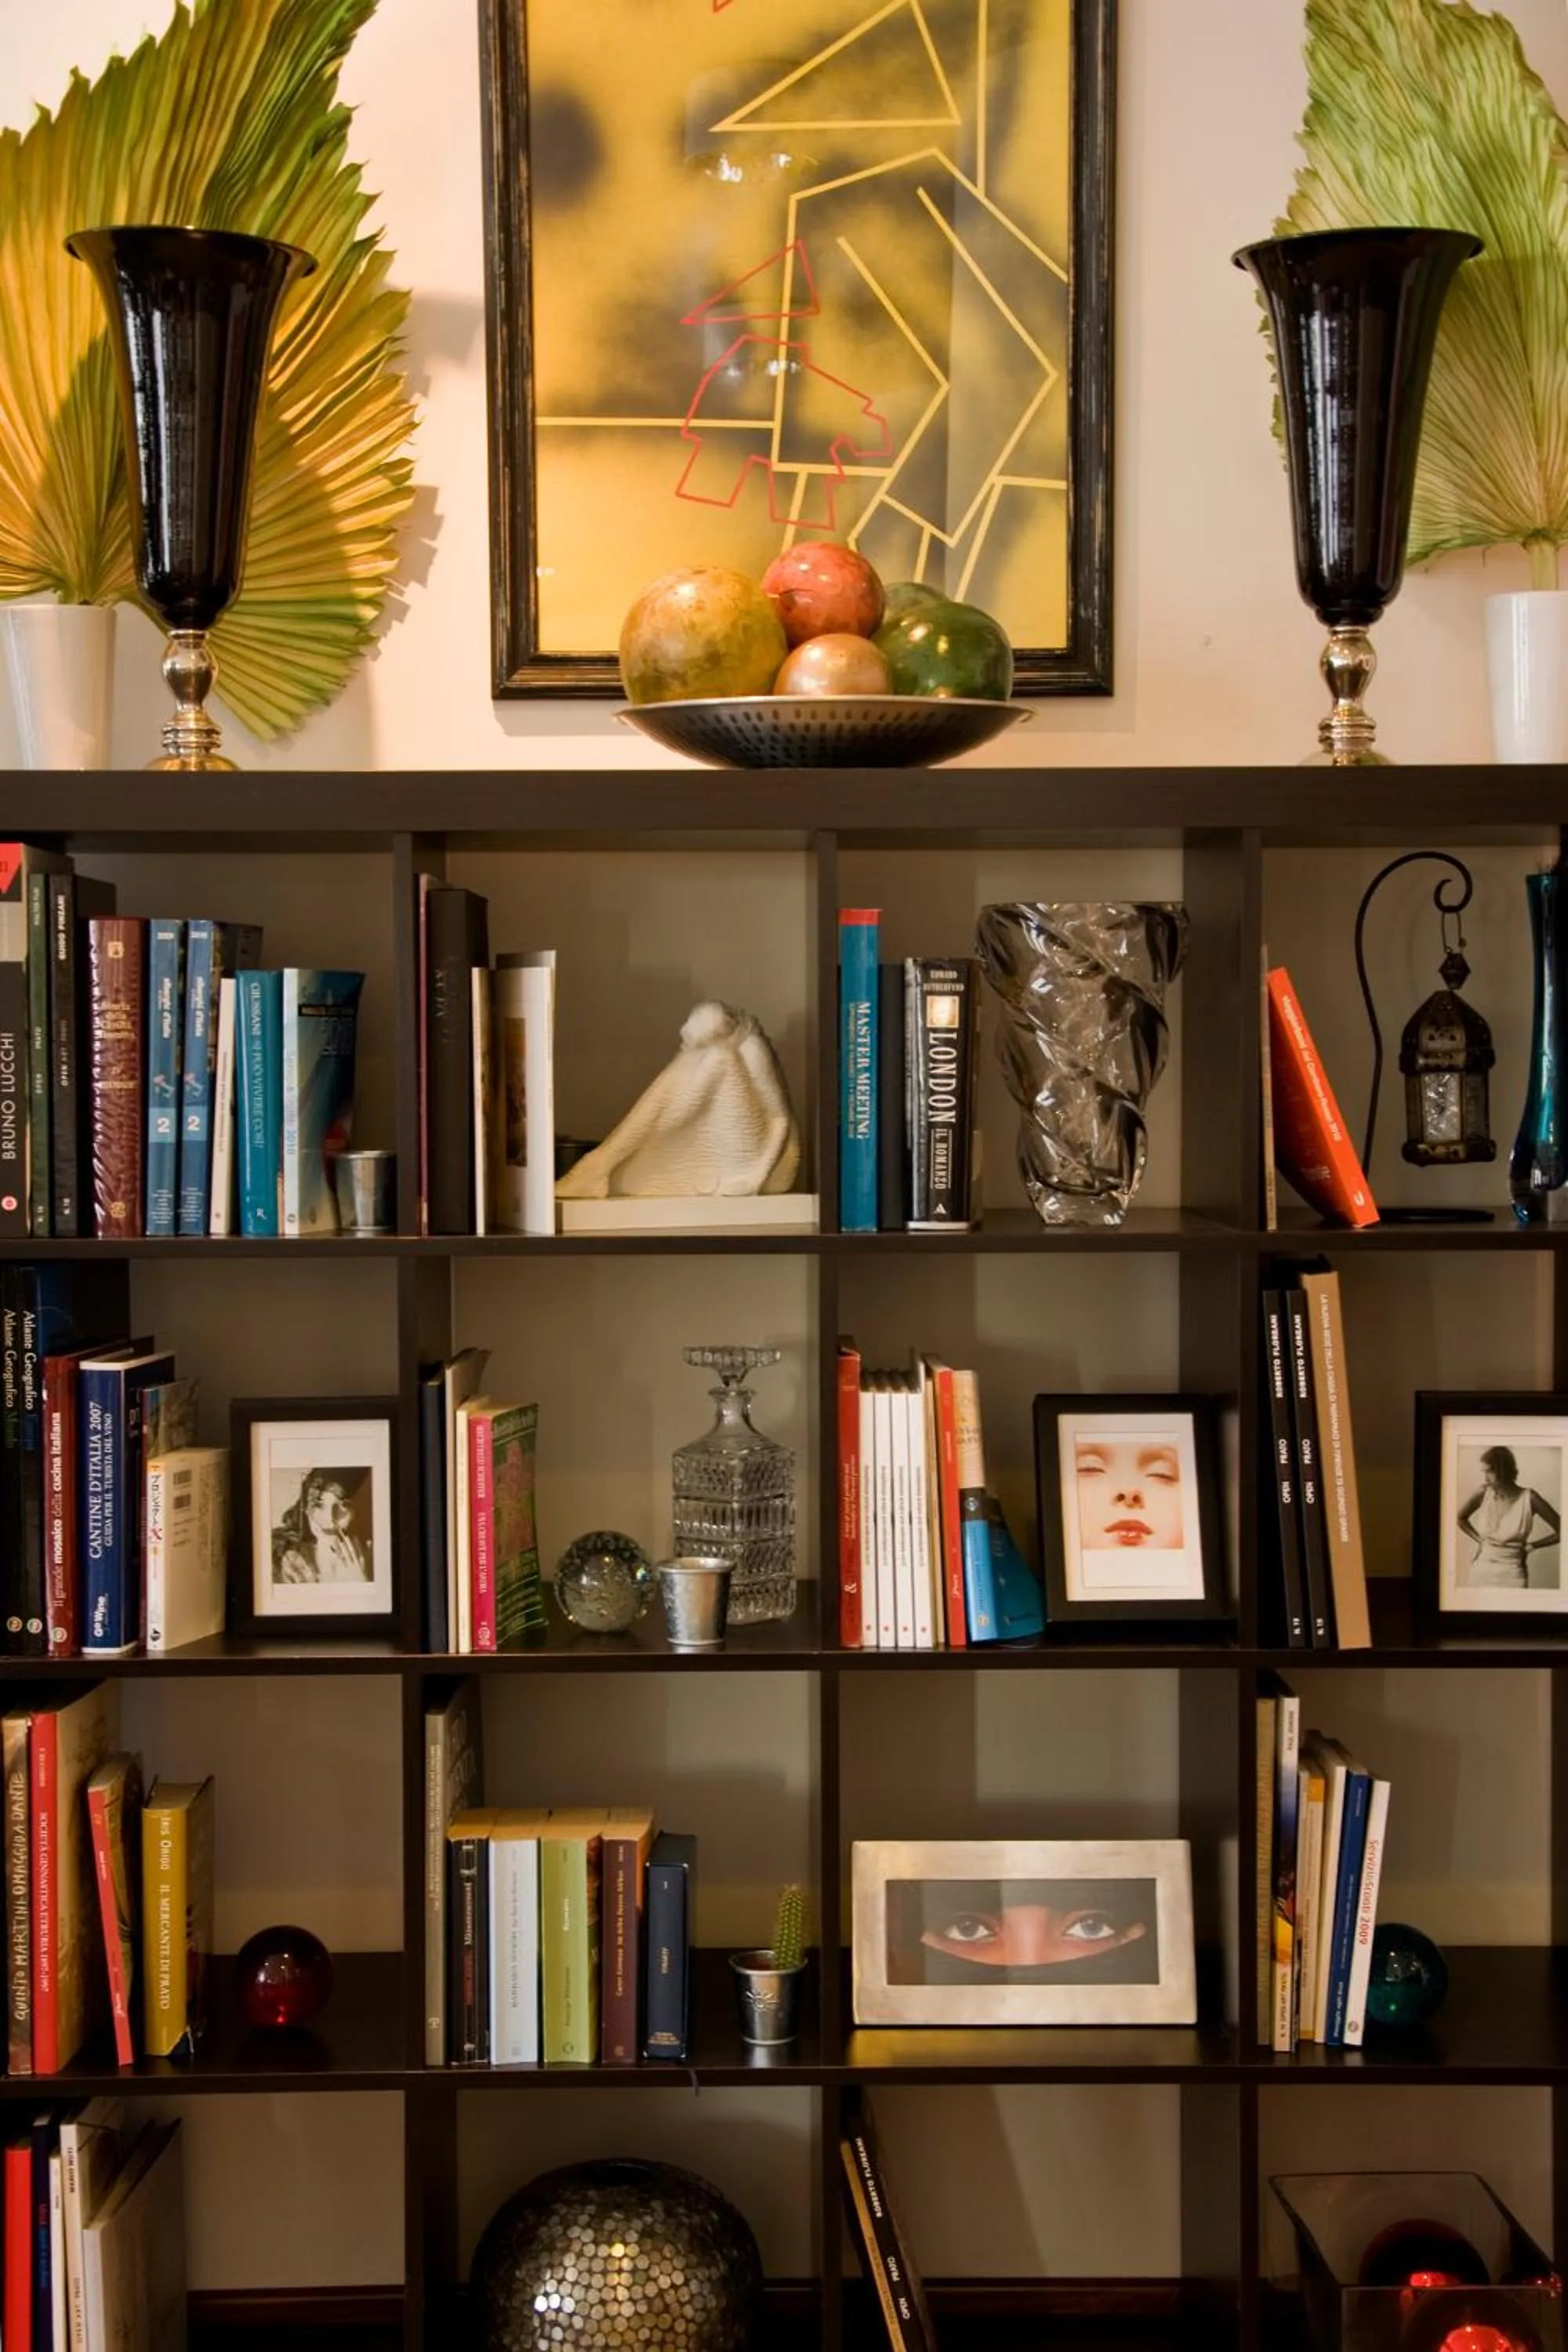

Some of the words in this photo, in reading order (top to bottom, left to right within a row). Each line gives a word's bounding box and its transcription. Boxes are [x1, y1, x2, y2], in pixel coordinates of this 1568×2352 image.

[57, 932, 67, 960] GUIDO
[250, 982, 261, 1036] GIUSSANI
[856, 1002, 871, 1068] MASTER
[1, 1032, 15, 1093] LUCCHI
[928, 1032, 957, 1123] LONDON
[252, 1077, 264, 1116] VIVERE
[855, 1071, 871, 1140] MEETING
[1, 1100, 16, 1160] BRUNO
[157, 1116, 170, 1133] 2
[187, 1115, 201, 1131] 2
[935, 1128, 948, 1139] IL
[934, 1142, 948, 1189] ROMANZO
[3, 1308, 16, 1347] Atlante
[23, 1310, 36, 1349] Atlante
[2, 1350, 18, 1408] Geografico
[22, 1352, 37, 1410] Geografico
[1273, 1358, 1284, 1398] ROBERTO
[1297, 1358, 1308, 1398] ROBERTO
[49, 1412, 61, 1454] italiana
[89, 1401, 103, 1431] 2007
[103, 1413, 113, 1436] VINO
[89, 1434, 102, 1492] D'ITALIA
[103, 1436, 113, 1453] DEL
[1279, 1439, 1290, 1464] PRATO
[1302, 1438, 1313, 1465] PRATO
[50, 1457, 62, 1492] cucina
[103, 1454, 113, 1489] TURISTA
[103, 1491, 113, 1500] IL
[103, 1501, 113, 1517] PER
[1281, 1481, 1292, 1504] OPEN
[1304, 1481, 1316, 1504] OPEN
[50, 1519, 63, 1564] mosaico
[89, 1495, 102, 1559] CANTINE
[103, 1519, 113, 1546] GUIDA
[12, 1771, 25, 1820] DANTE
[159, 1884, 170, 1894] IL
[159, 1897, 170, 1958] MERCANTE
[159, 1958, 170, 1972] DI
[13, 1971, 29, 2020] QUINTO
[159, 1973, 170, 2009] PRATO
[866, 2180, 884, 2218] ROBERTO
[887, 2256, 901, 2282] PRATO
[898, 2296, 911, 2320] OPEN
